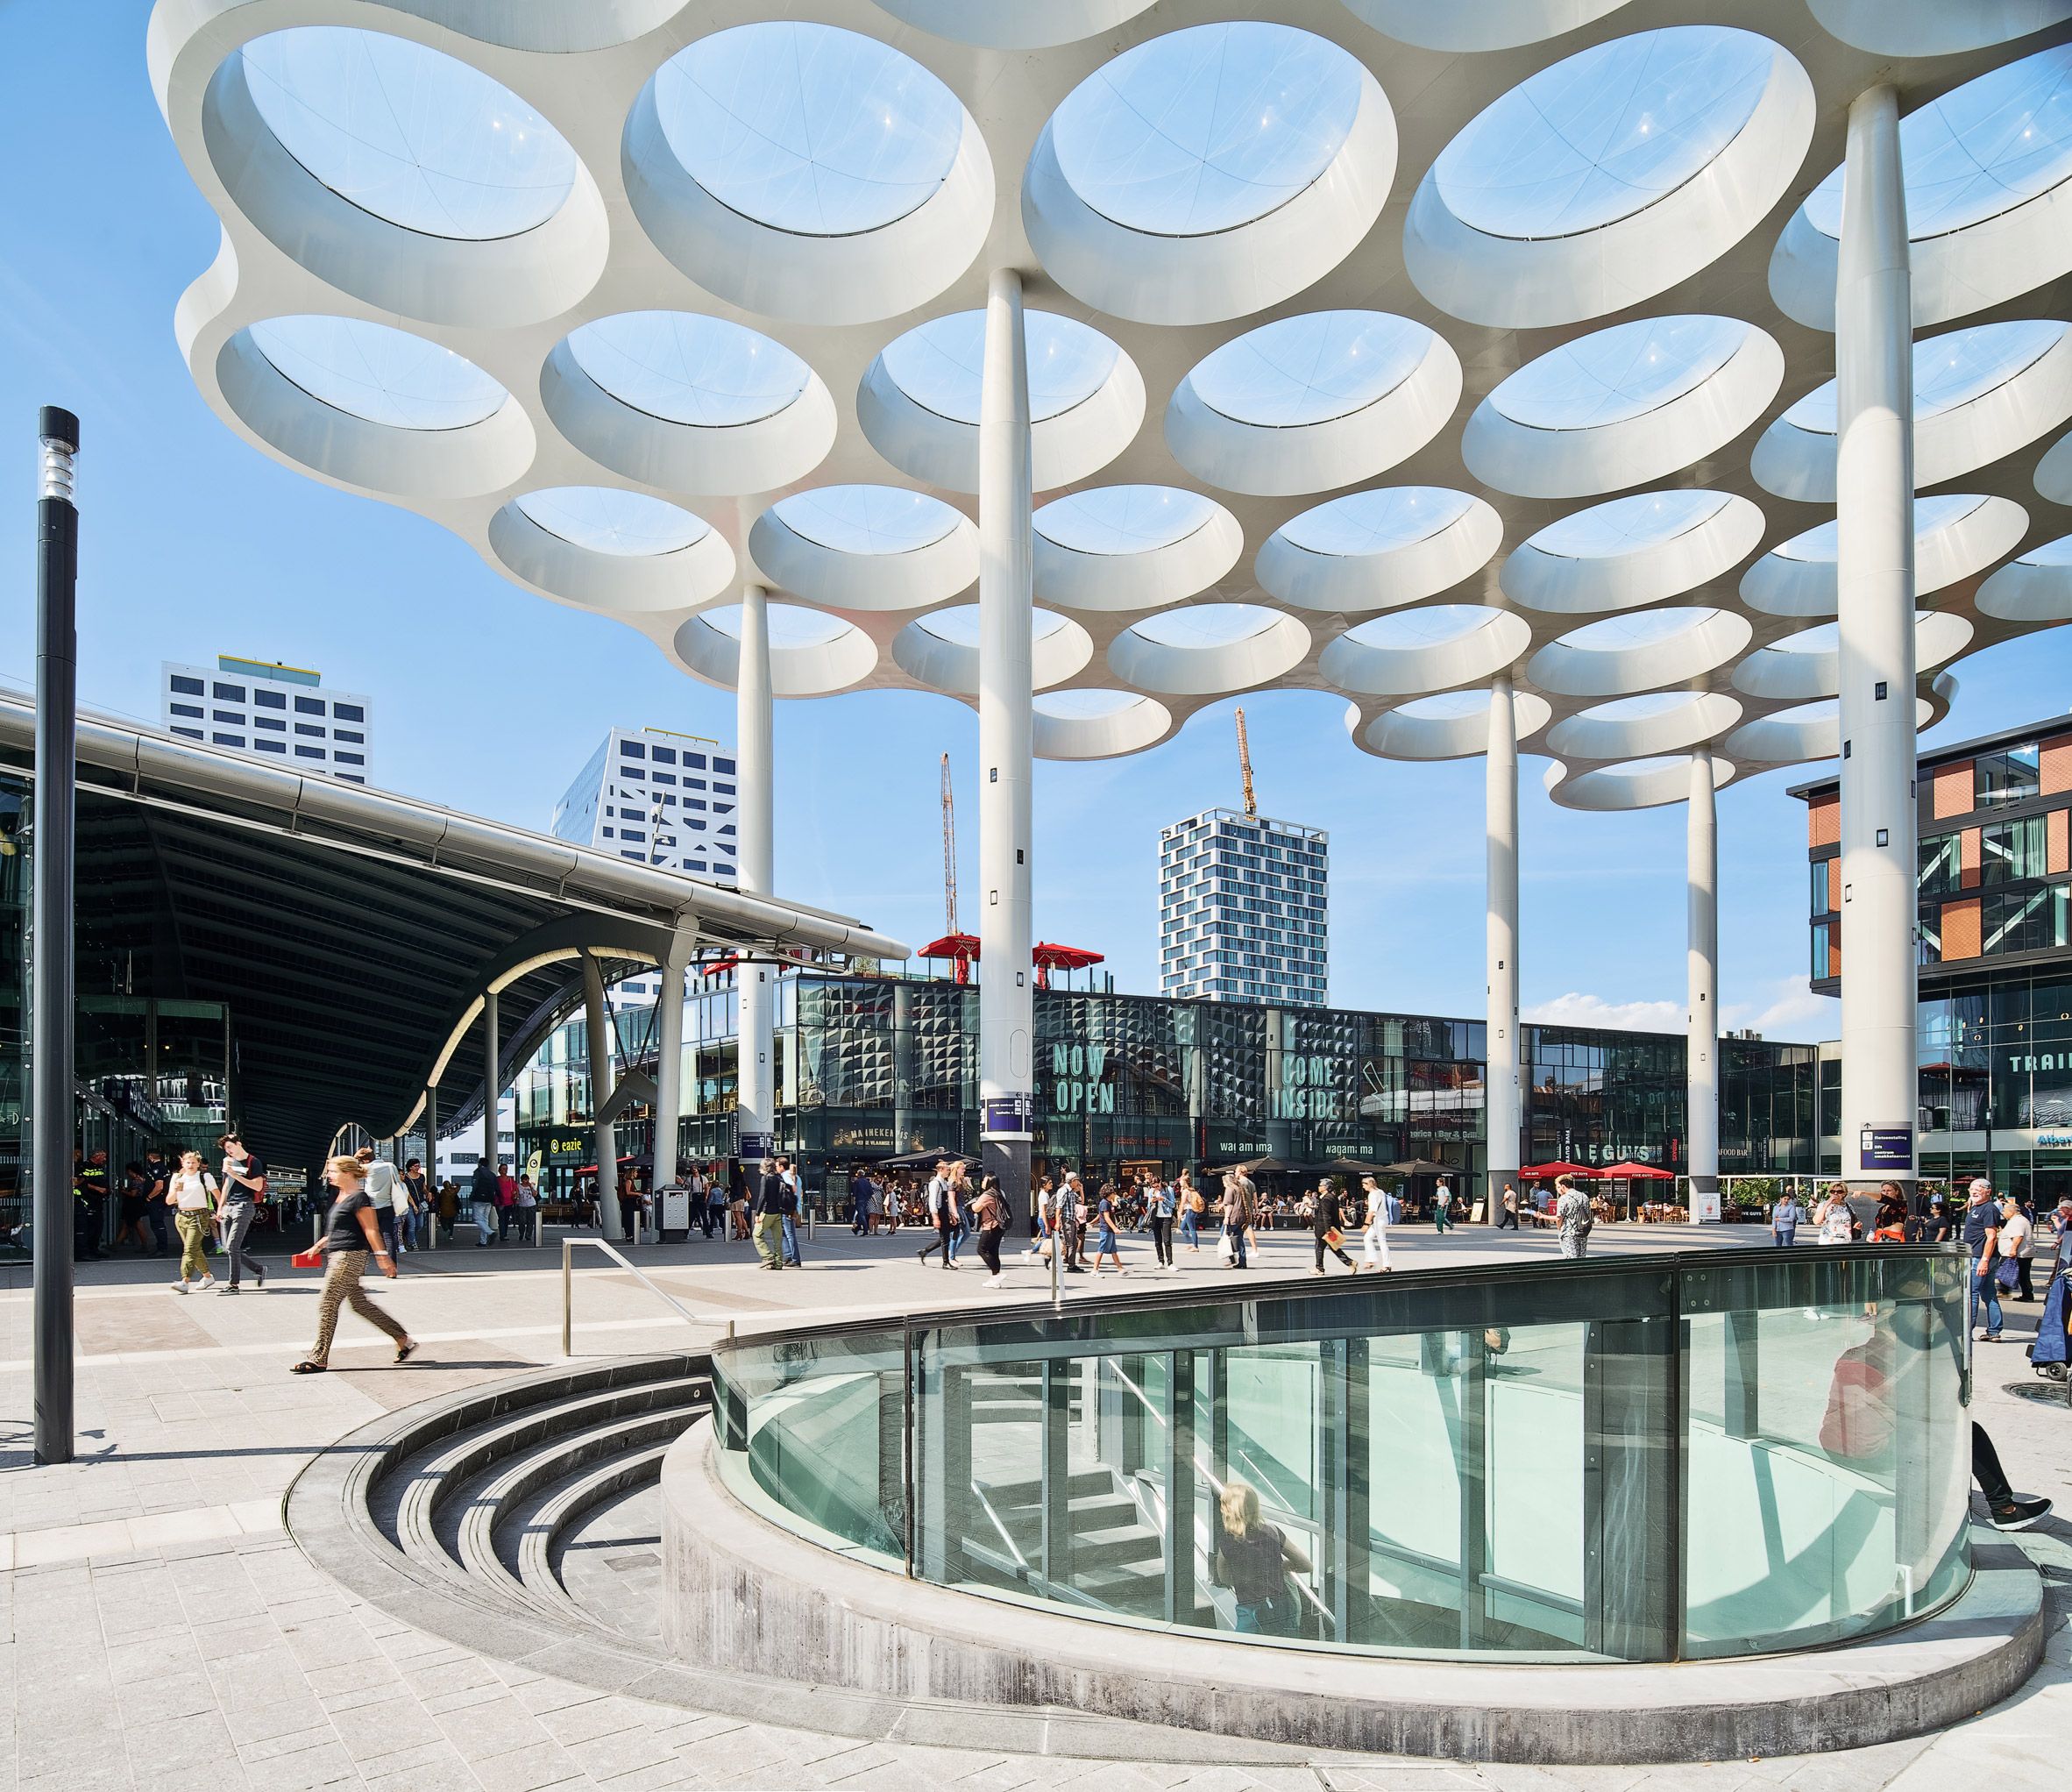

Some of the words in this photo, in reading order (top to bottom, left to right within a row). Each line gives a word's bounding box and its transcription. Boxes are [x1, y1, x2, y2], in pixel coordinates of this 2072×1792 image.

[1054, 1043, 1104, 1077] NOW
[1282, 1056, 1334, 1087] COME
[2009, 1053, 2072, 1072] TRAI
[1057, 1081, 1114, 1113] OPEN
[1274, 1090, 1338, 1120] INSIDE
[562, 1138, 582, 1151] eazie
[1602, 1144, 1650, 1162] GUYS
